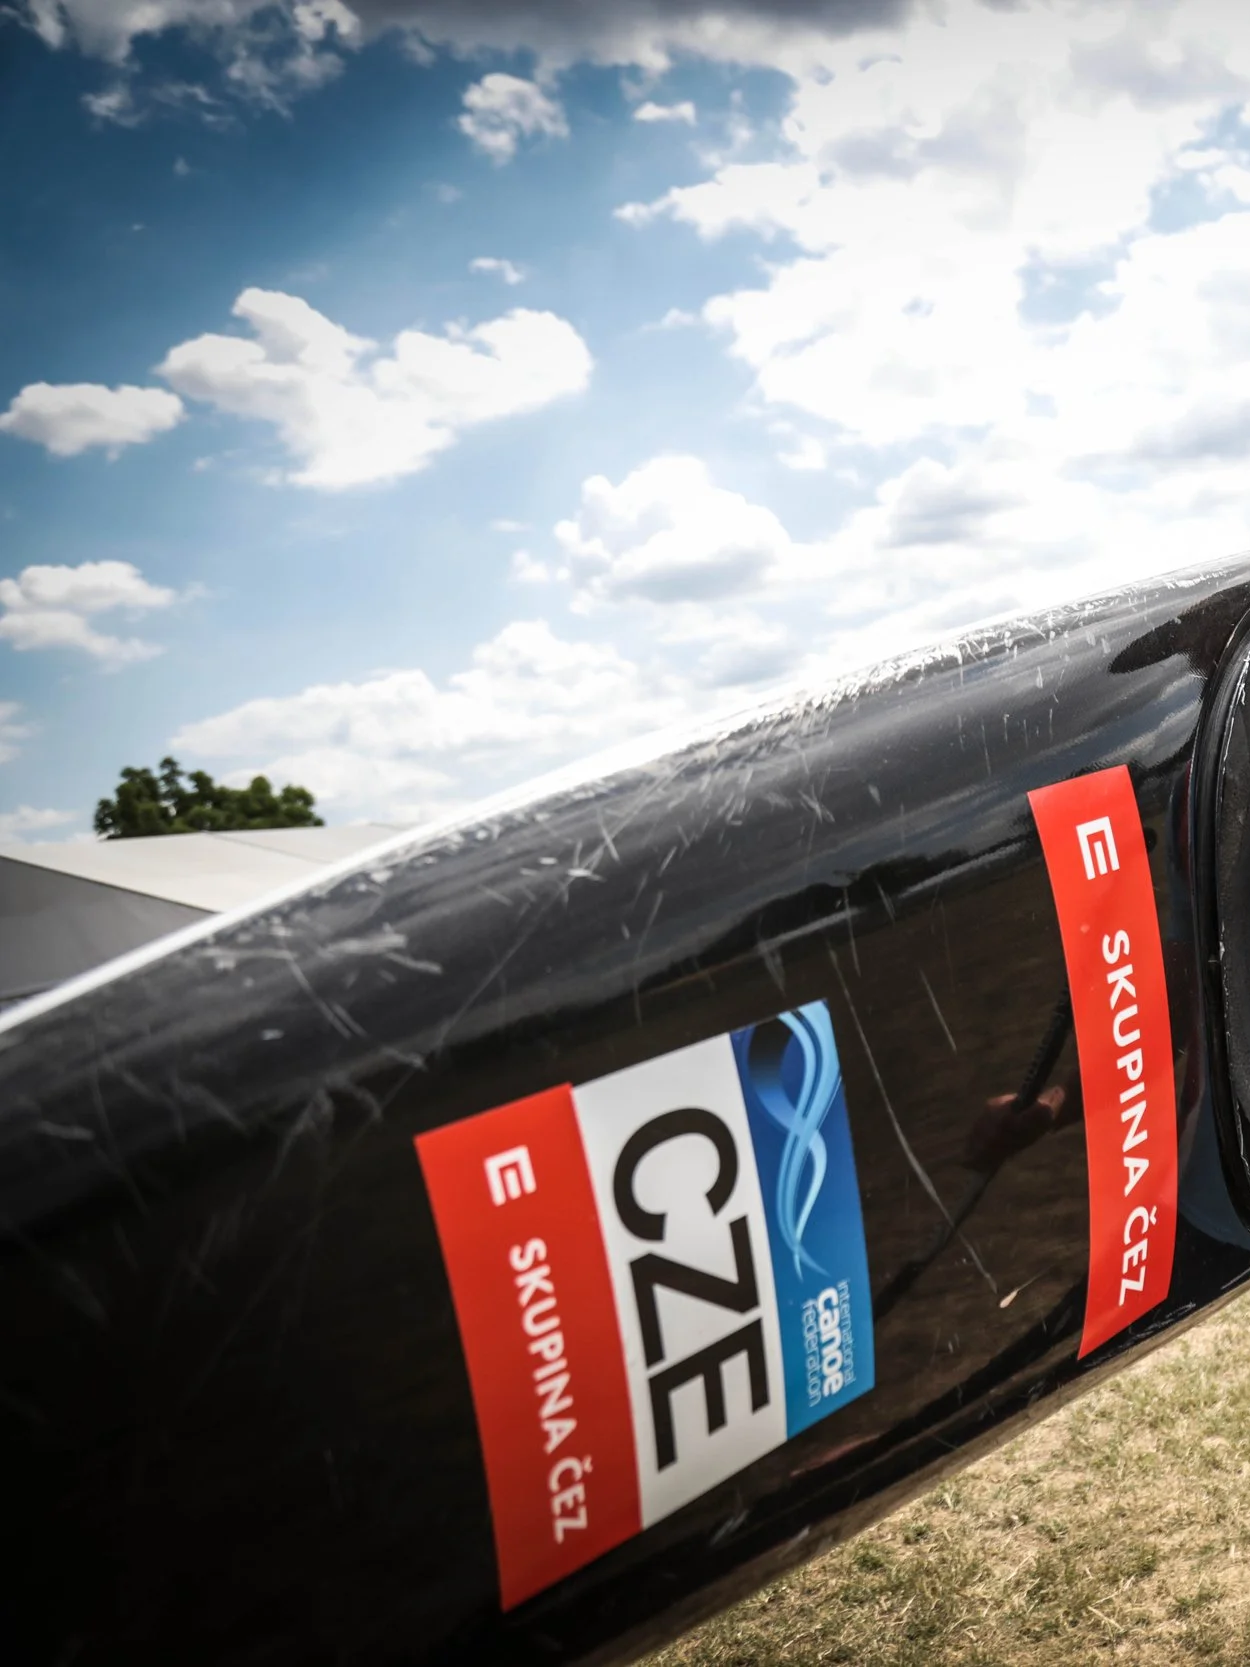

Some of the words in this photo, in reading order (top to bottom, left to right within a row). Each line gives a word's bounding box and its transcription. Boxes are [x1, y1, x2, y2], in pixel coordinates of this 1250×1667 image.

[1102, 929, 1150, 1197] SKUPINA
[612, 1106, 771, 1474] CZE
[1118, 1205, 1157, 1306] ČEZ
[802, 1298, 822, 1408] federation
[817, 1286, 844, 1398] canoe
[837, 1278, 857, 1387] international
[509, 1238, 578, 1454] SKUPINA
[547, 1456, 594, 1544] ČEZ
